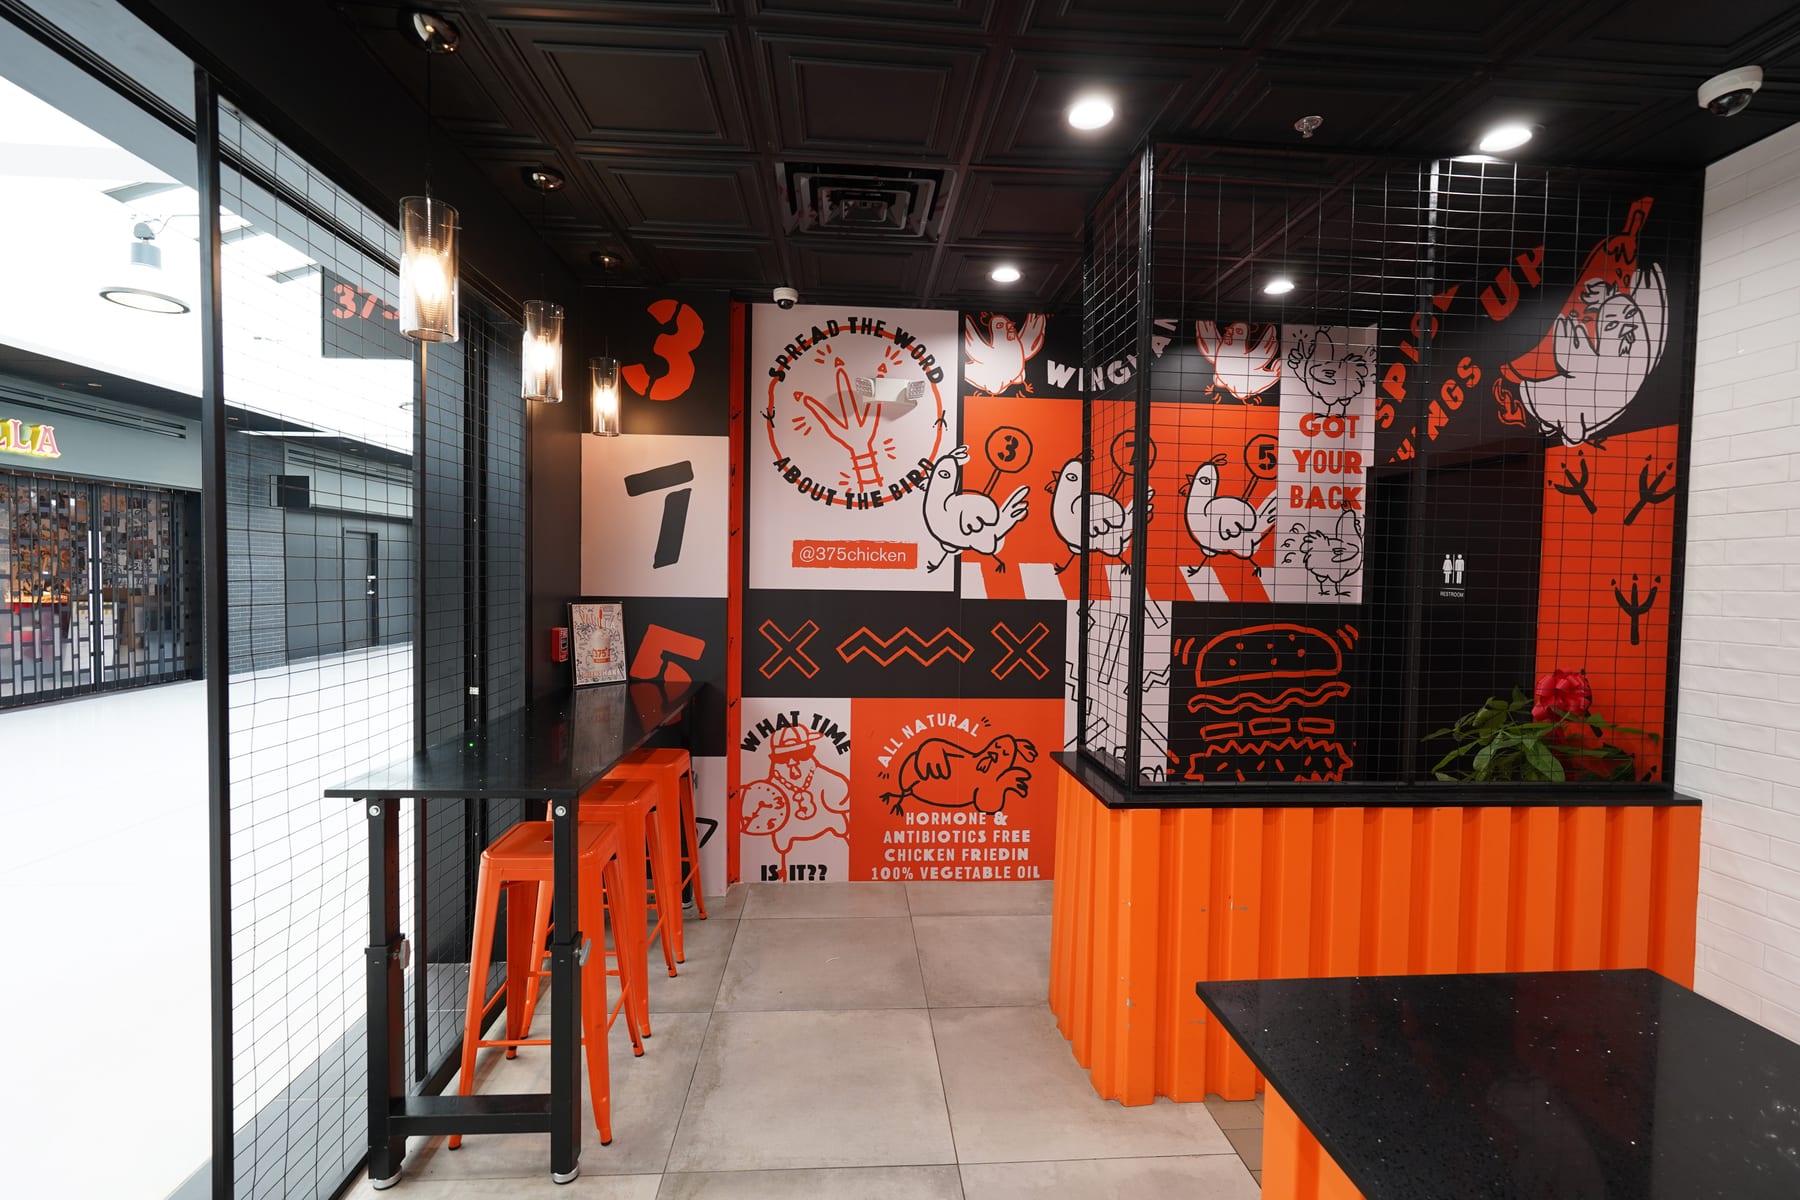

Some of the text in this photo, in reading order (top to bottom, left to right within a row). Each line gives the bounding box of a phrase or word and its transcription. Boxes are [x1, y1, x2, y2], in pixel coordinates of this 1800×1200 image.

[621, 299, 705, 401] 3
[768, 317, 944, 384] SPREAD THE WORD
[0, 419, 60, 458] LA
[1299, 413, 1360, 439] GOT
[997, 435, 1019, 462] 3
[1258, 444, 1277, 470] 5
[1291, 449, 1363, 474] YOUR
[773, 456, 935, 510] ABOUT THE BIRD
[1290, 485, 1364, 510] BACK
[624, 460, 694, 570] 7
[799, 545, 907, 563] @375chicken
[740, 711, 851, 755] WHAT TIME
[878, 713, 980, 768] ALL NATURAL
[906, 811, 1008, 826] HORMONE &
[883, 830, 1031, 843] ANTIBIOTICS FREE
[884, 848, 955, 862] CHICKEN
[760, 864, 828, 881] IS IT??
[871, 866, 1041, 880] 100% VEGETABLE OIL
